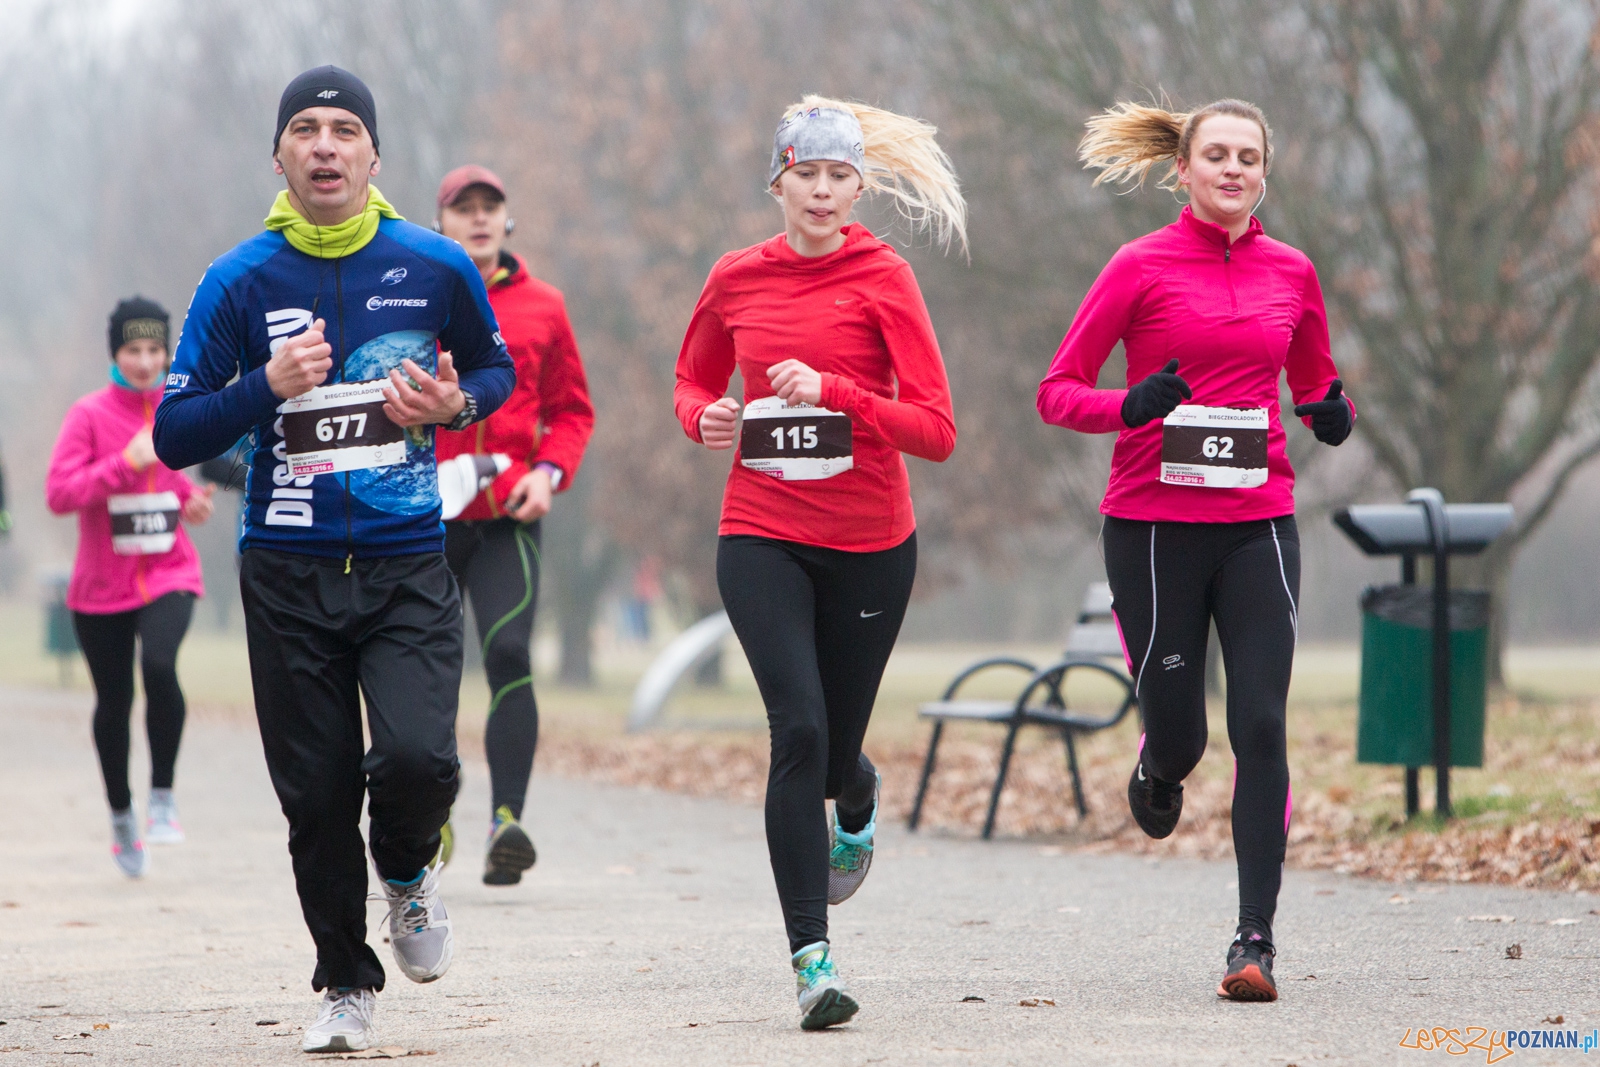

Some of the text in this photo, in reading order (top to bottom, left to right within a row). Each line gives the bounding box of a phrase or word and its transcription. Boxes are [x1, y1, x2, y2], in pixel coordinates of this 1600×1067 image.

[316, 89, 339, 99] 4F
[382, 298, 428, 307] FITNESS
[1208, 414, 1265, 422] BIEGCZEKOLADOWY.PL
[315, 412, 368, 442] 677
[770, 425, 818, 450] 115
[1202, 435, 1234, 459] 62
[293, 464, 327, 474] 14.02.2016
[1166, 475, 1198, 483] 14.02.2016
